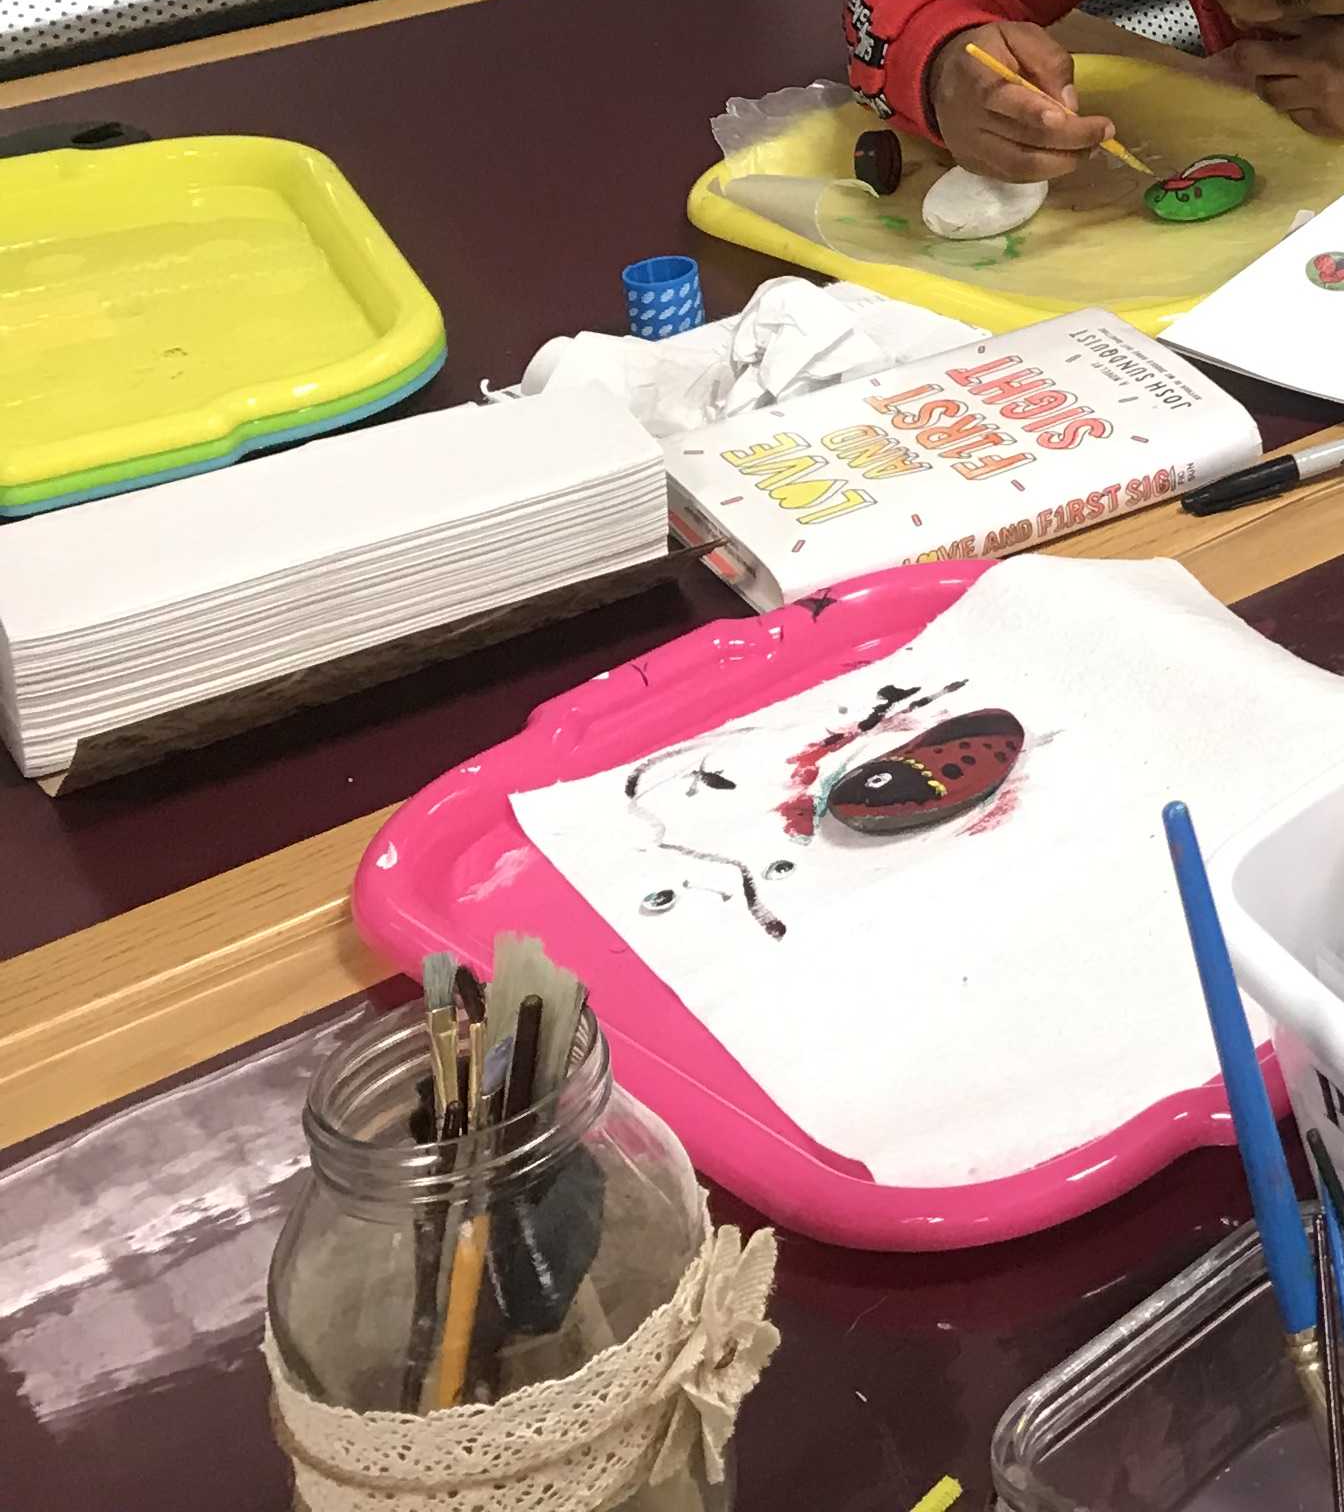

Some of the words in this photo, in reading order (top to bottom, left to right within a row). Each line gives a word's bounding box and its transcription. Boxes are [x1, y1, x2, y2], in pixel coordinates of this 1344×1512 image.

[1069, 329, 1155, 382] SUNDQUIST
[946, 355, 1114, 451] SIGHT
[1144, 381, 1192, 409] JOSH
[820, 424, 933, 480] AND
[982, 518, 1033, 555] AND
[1125, 469, 1170, 506] SIG
